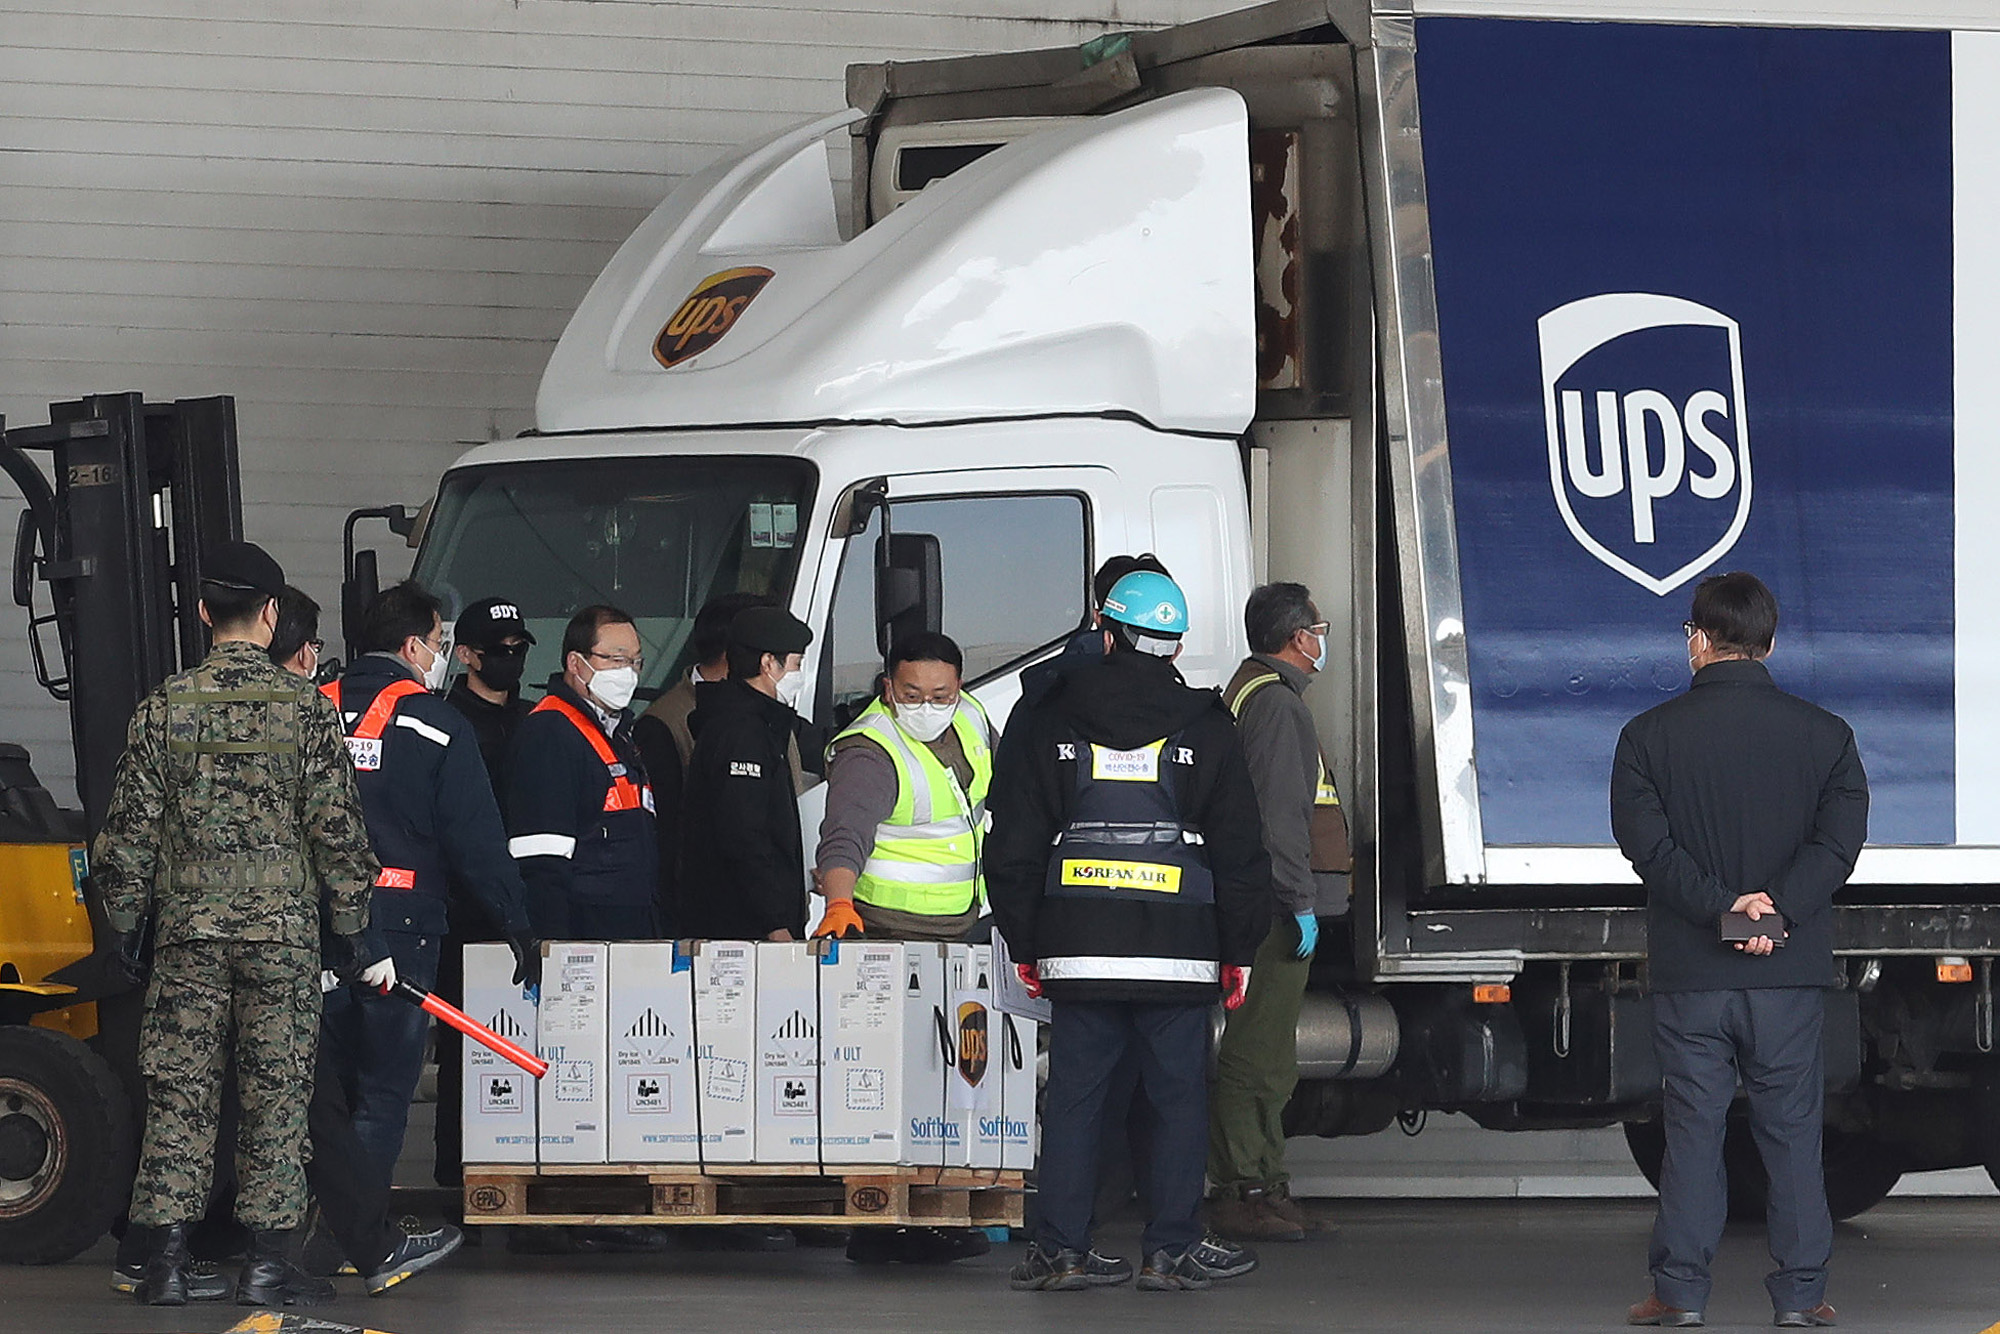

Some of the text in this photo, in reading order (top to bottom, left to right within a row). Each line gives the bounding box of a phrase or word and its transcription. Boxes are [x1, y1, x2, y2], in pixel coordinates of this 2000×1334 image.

[667, 295, 748, 352] ups
[1561, 388, 1736, 543] ups
[68, 466, 111, 485] 2-16
[489, 604, 519, 620] SDT
[344, 740, 373, 752] D-19
[1108, 752, 1146, 762] COVID-19
[1072, 866, 1167, 884] KOREAN AIR
[548, 1046, 565, 1061] ULT
[843, 1046, 861, 1061] ULT
[961, 1029, 986, 1073] ups
[911, 1117, 960, 1139] Softbox
[979, 1116, 1029, 1137] Softbox
